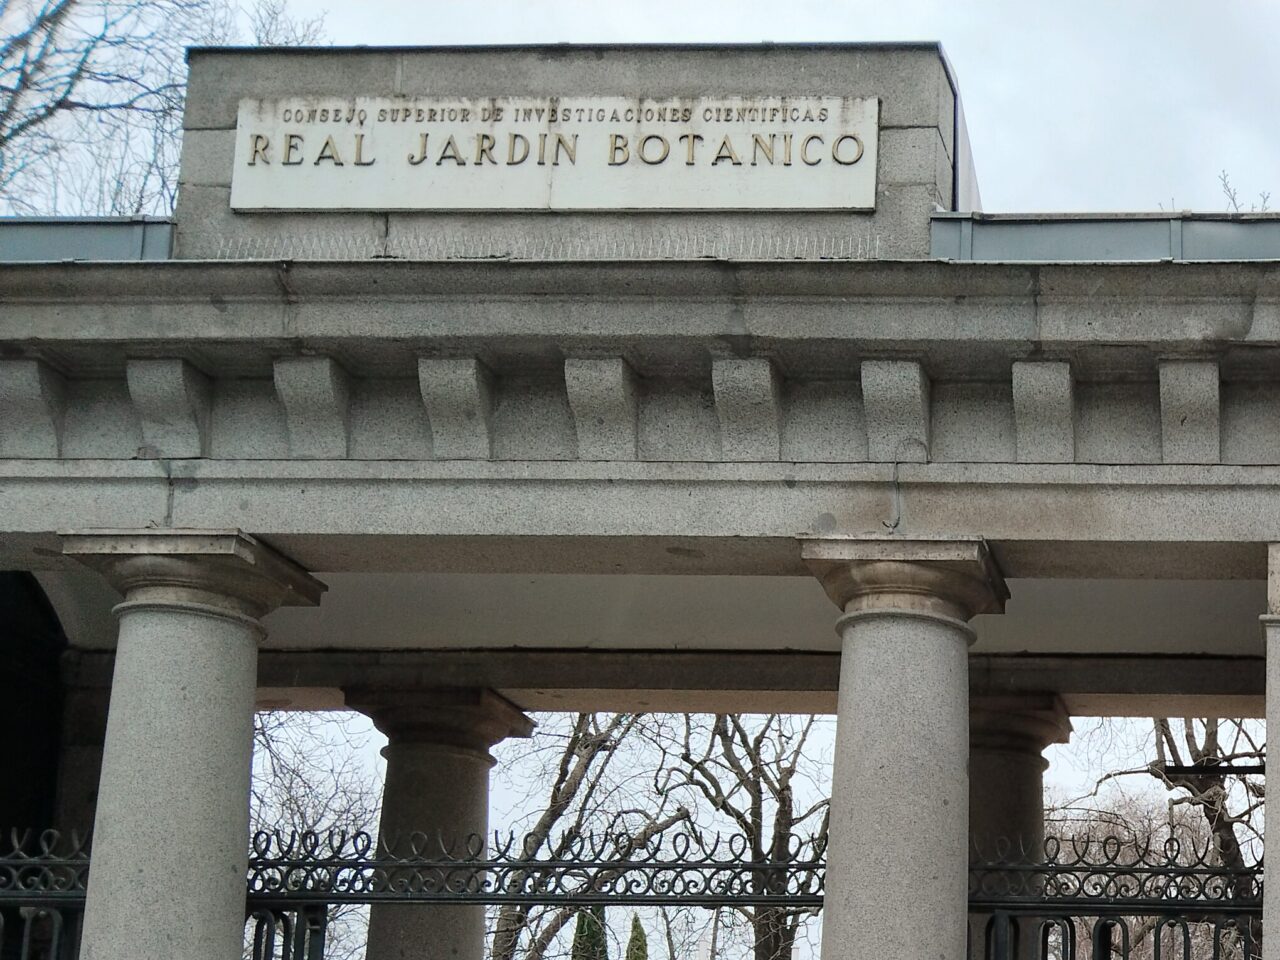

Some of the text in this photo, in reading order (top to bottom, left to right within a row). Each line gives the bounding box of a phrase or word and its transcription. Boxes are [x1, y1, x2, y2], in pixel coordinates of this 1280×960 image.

[283, 107, 829, 125] CONSEJO SUPERIOR DE INVESTIGACIONES CIENTIFICAS
[247, 132, 865, 167] REAL JARDIN BOTANICO
